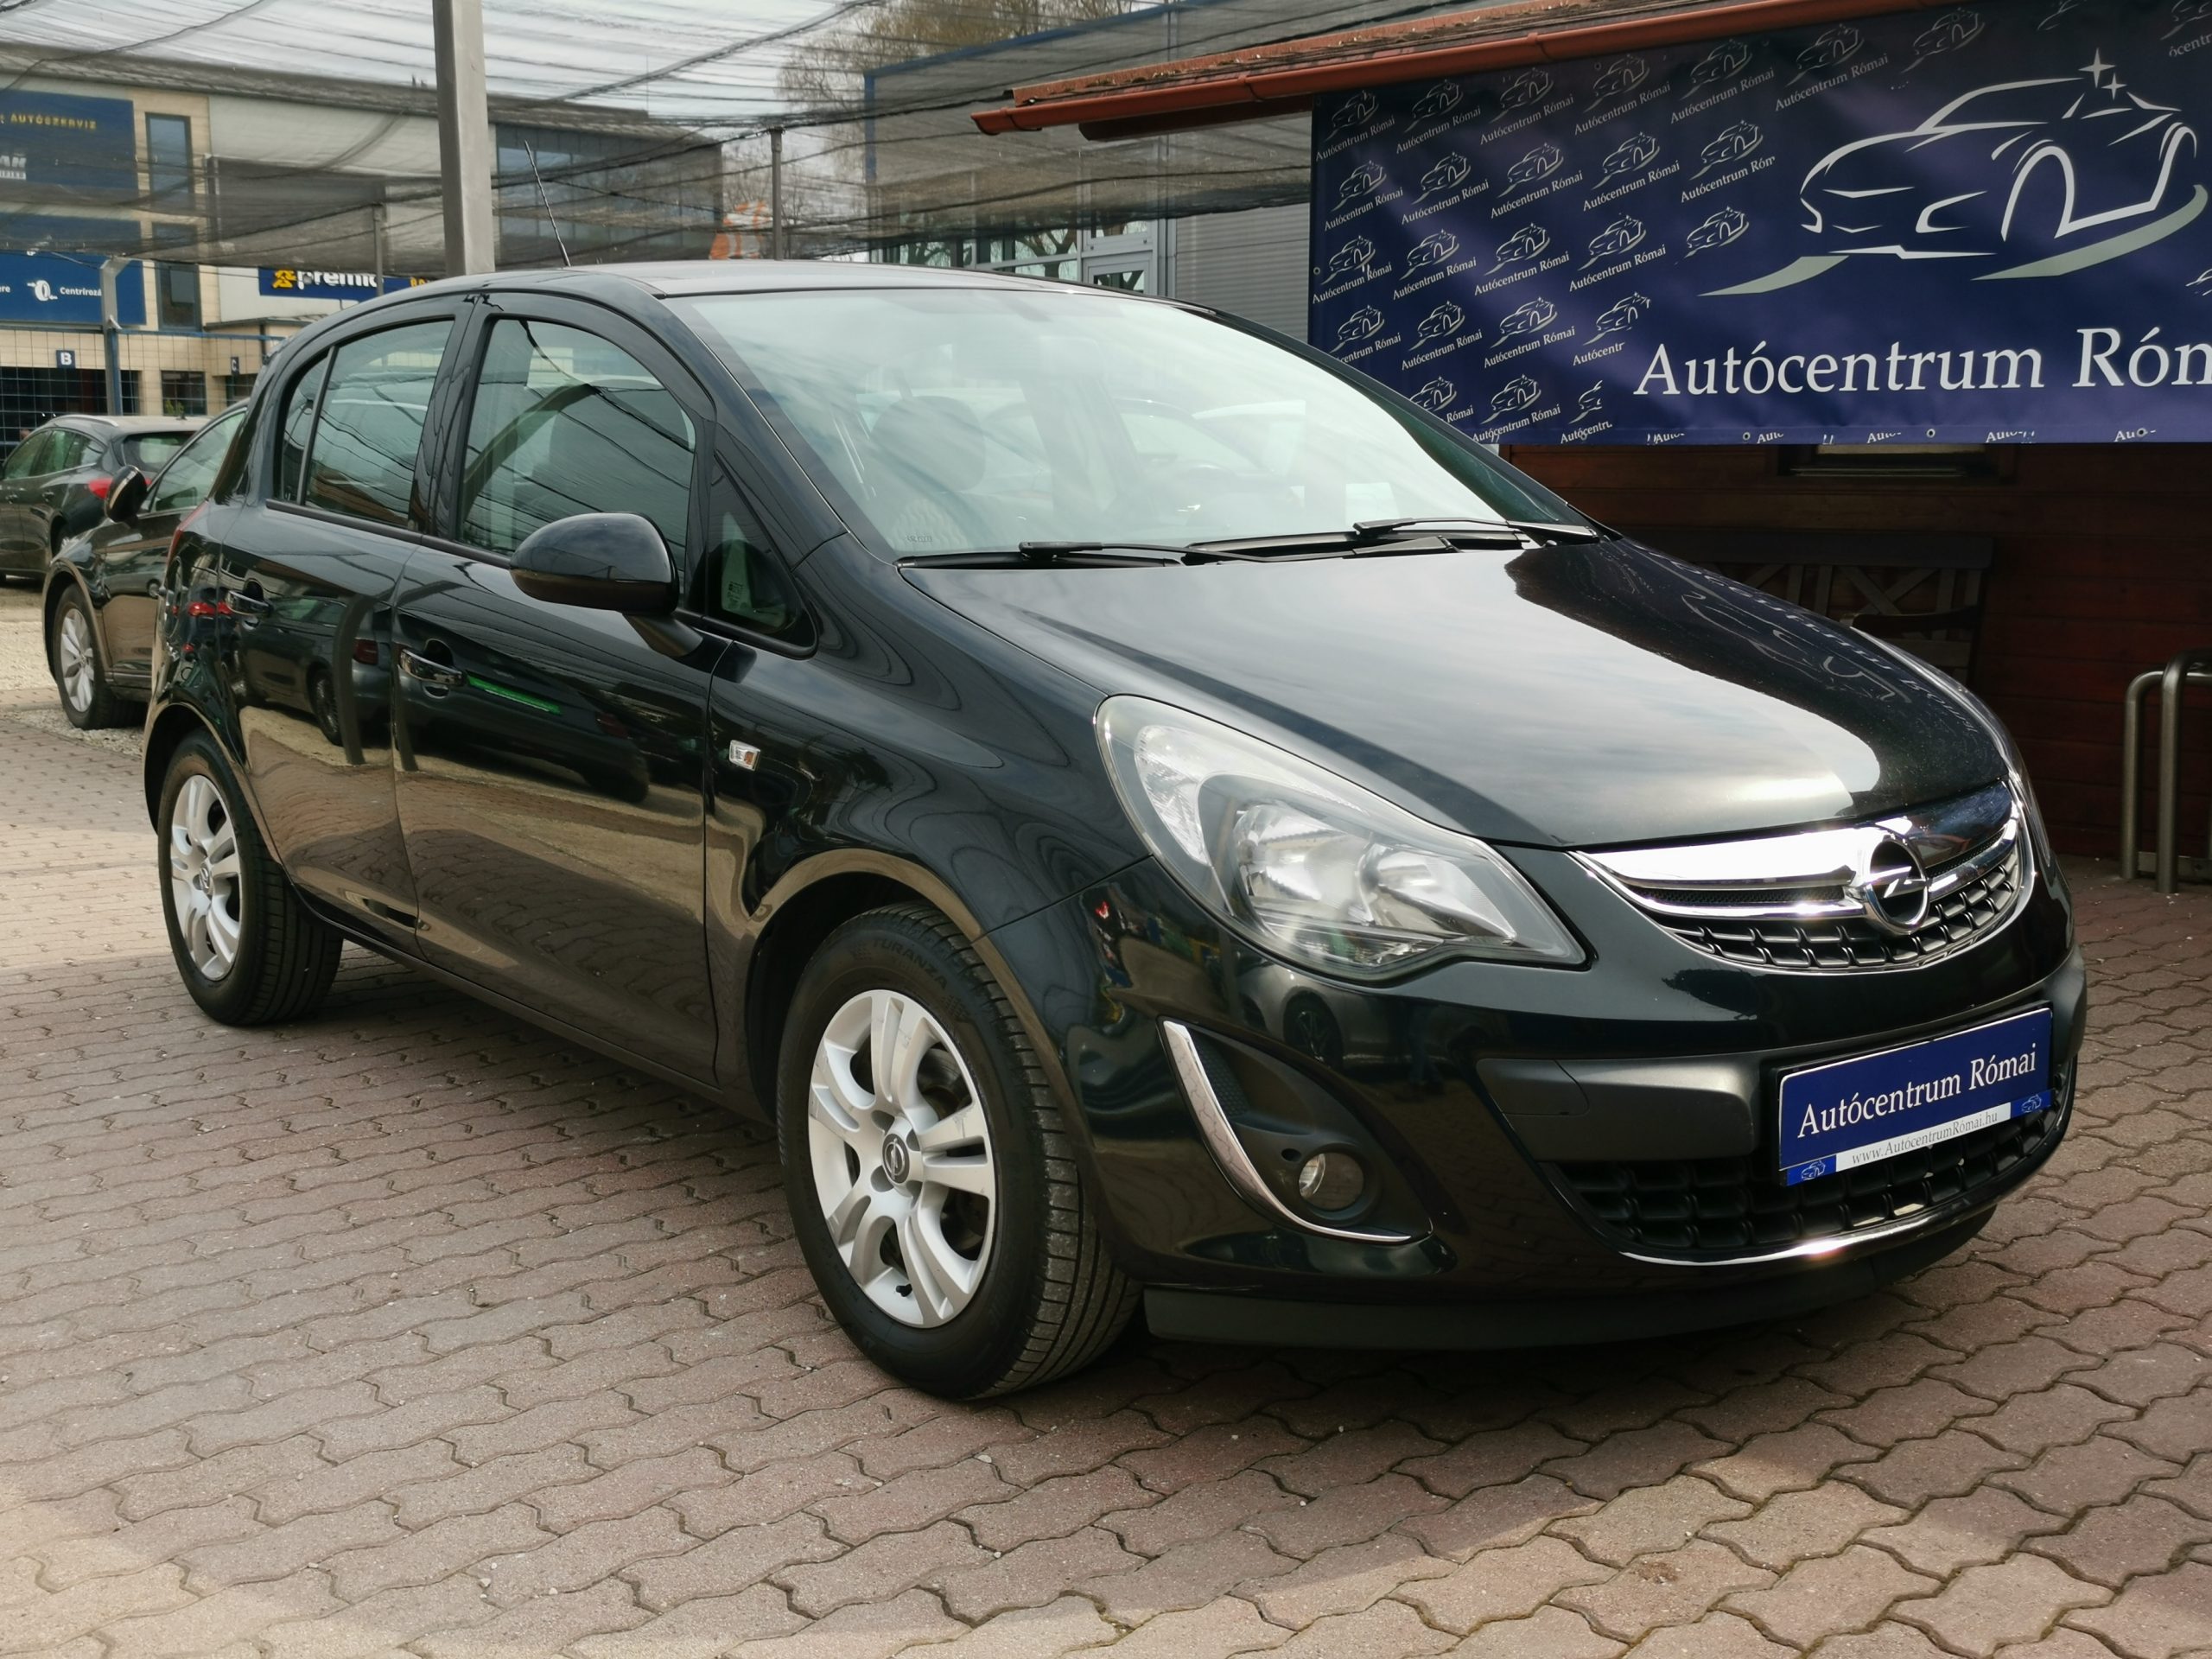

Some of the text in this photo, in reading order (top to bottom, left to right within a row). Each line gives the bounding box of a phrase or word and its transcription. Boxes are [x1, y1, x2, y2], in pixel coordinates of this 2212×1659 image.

[1670, 67, 1775, 124] Autócentrum Római
[1775, 54, 1889, 111] Autócentrum Római
[1395, 105, 1481, 154] Autócentrum Római
[1479, 93, 1574, 145] Autócentrum Római
[1574, 81, 1671, 135] Autócentrum Római
[1315, 115, 1395, 162] Autócentrum Római
[1401, 179, 1490, 225] Autócentrum Római
[1491, 170, 1583, 219] Autócentrum Római
[1583, 160, 1680, 212] Autócentrum Római
[1681, 168, 1748, 203] Autócentrum
[1324, 187, 1403, 232] Autócentrum Római
[1313, 275, 1365, 304] Autócentrum
[1392, 257, 1477, 300] Autócentrum Római
[1474, 251, 1570, 296] Autócentrum Római
[1569, 245, 1667, 292] Autócentrum Római
[60, 352, 72, 365] B
[1375, 332, 1402, 352] Római
[1402, 329, 1483, 371] Autócentrum Római
[1484, 326, 1575, 368] Autócentrum Római
[1633, 340, 2044, 395] Autócentrum
[1446, 404, 1474, 423] Római
[1471, 404, 1560, 443] Autócentrum Római
[1797, 1042, 2037, 1139] Autócentrum Római
[1852, 1111, 1998, 1165] www.AutócentrumRómai.hu
